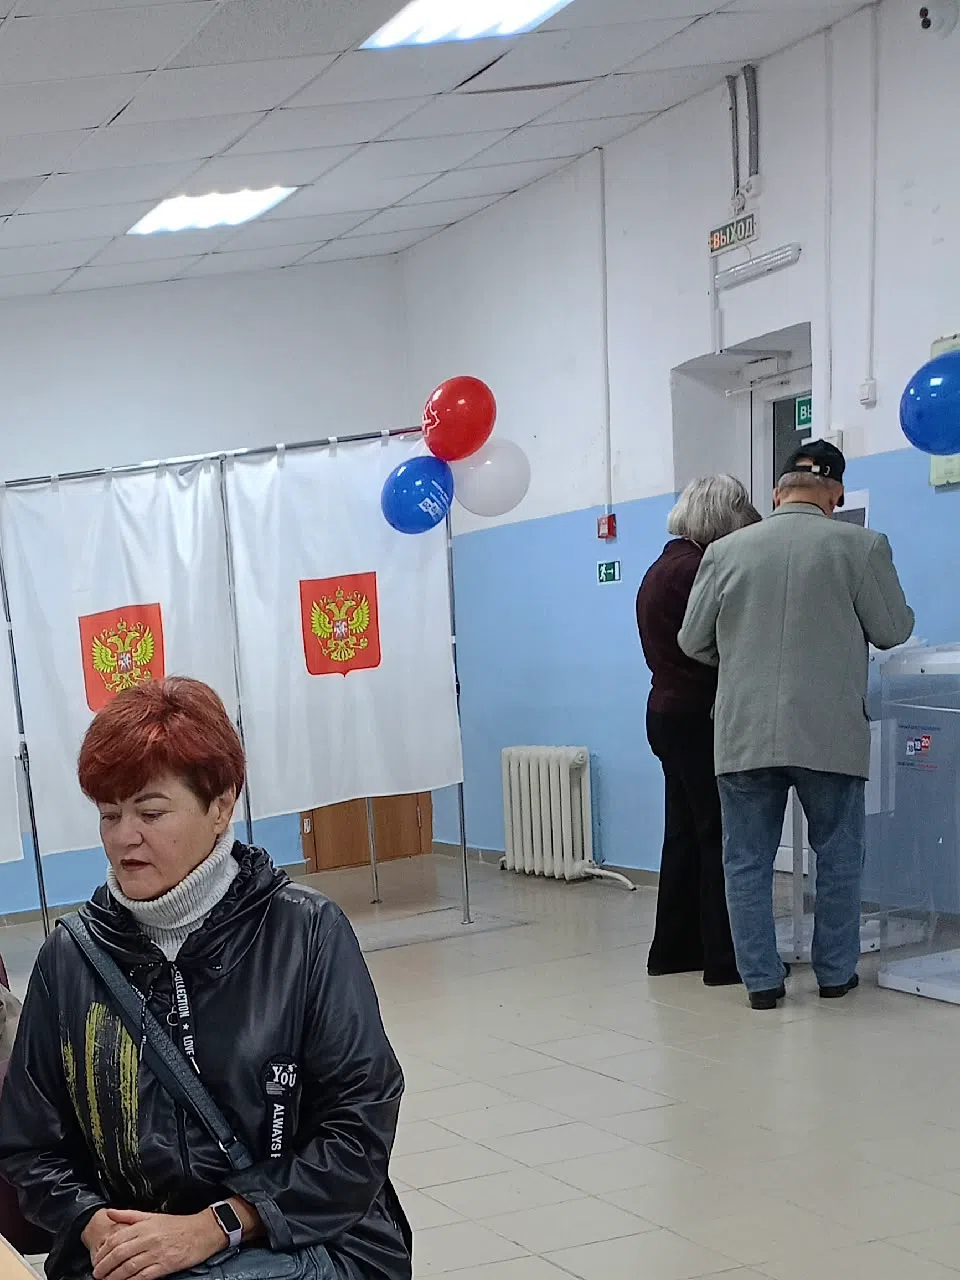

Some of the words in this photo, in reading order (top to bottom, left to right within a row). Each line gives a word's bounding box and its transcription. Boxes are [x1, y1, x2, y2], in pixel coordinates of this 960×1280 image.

[713, 217, 753, 249] ВЫХОД
[174, 970, 191, 1019] COLLECTION
[183, 1034, 195, 1056] LOVE
[272, 1065, 297, 1088] YOU
[271, 1103, 286, 1151] ALWAYS
